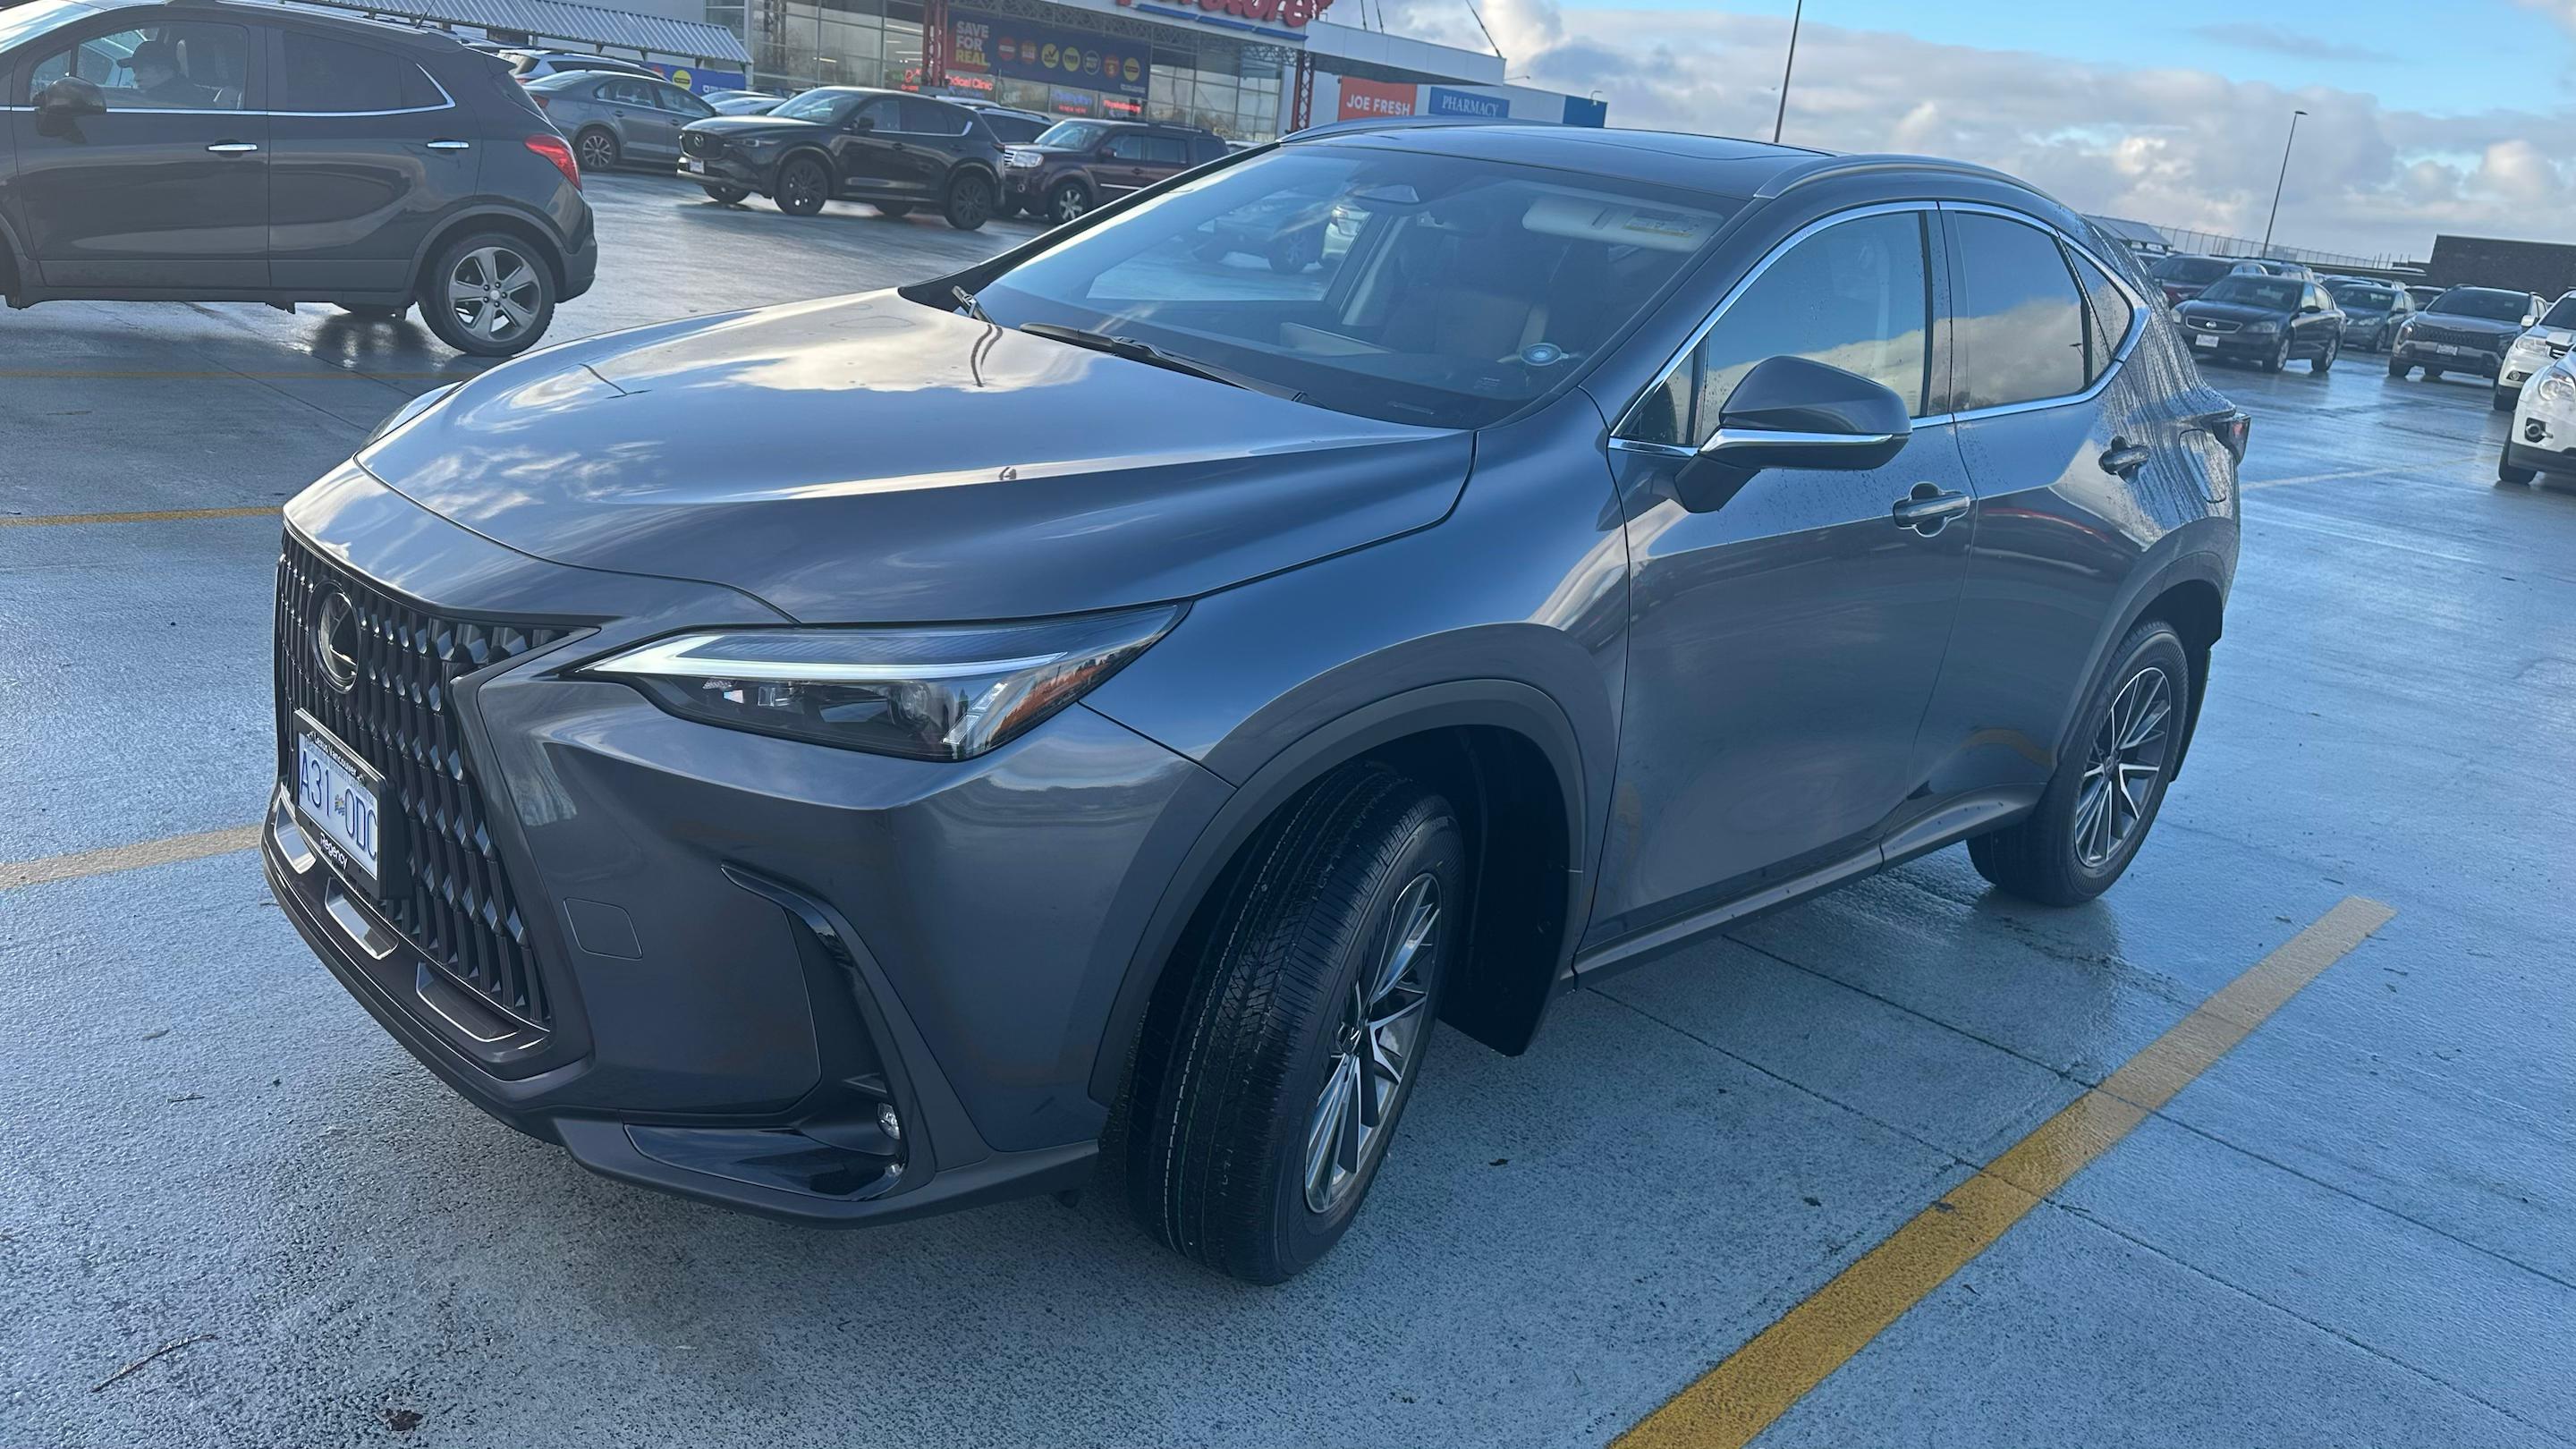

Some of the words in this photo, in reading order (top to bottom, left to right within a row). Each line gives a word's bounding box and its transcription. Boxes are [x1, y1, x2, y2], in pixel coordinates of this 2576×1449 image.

[956, 21, 988, 38] SAVE
[956, 35, 982, 52] FOR
[1346, 94, 1370, 110] JOE
[1373, 97, 1411, 116] FRESH
[1442, 95, 1500, 117] PHARMACY
[314, 732, 328, 754] Lexus
[328, 743, 357, 776] Vancouver
[300, 750, 329, 818] A31
[320, 832, 348, 870] Regency
